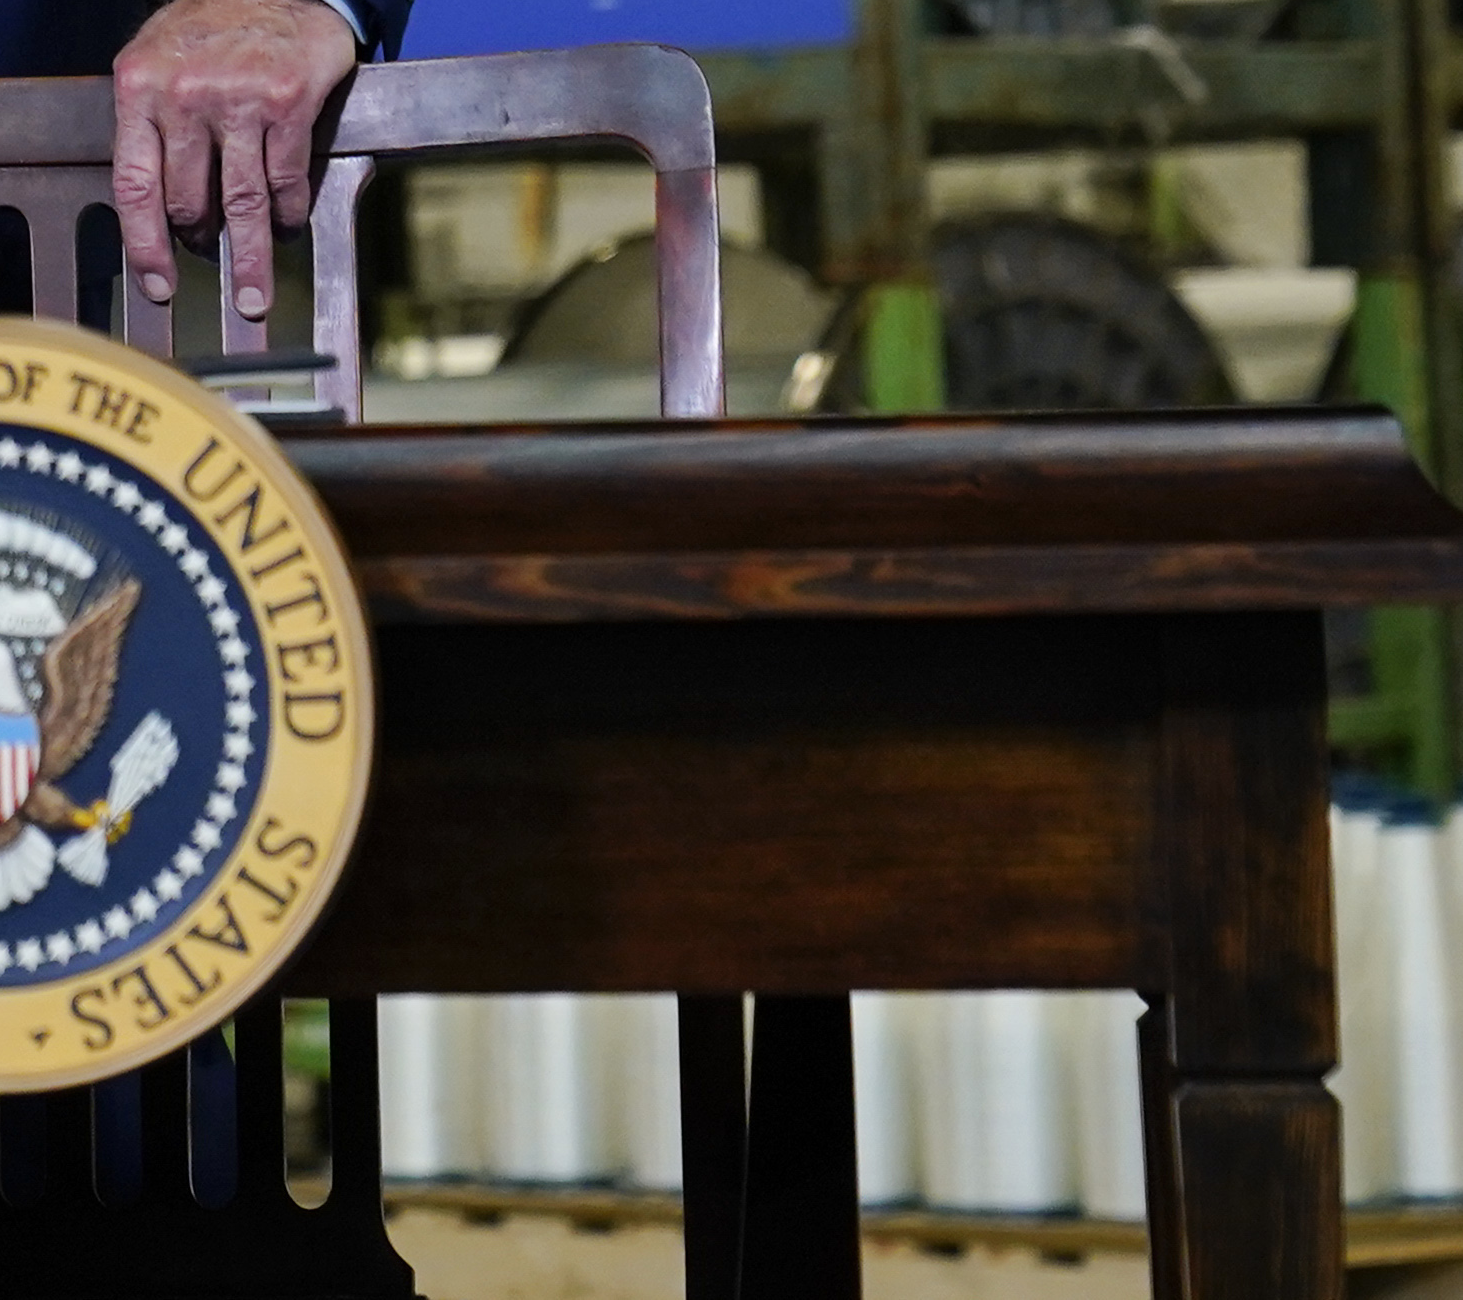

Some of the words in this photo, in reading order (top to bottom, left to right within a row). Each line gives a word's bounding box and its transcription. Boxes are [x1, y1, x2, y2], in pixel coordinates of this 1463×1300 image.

[71, 371, 159, 445] THE
[183, 439, 345, 743] UNITED
[69, 818, 316, 1050] STATES
